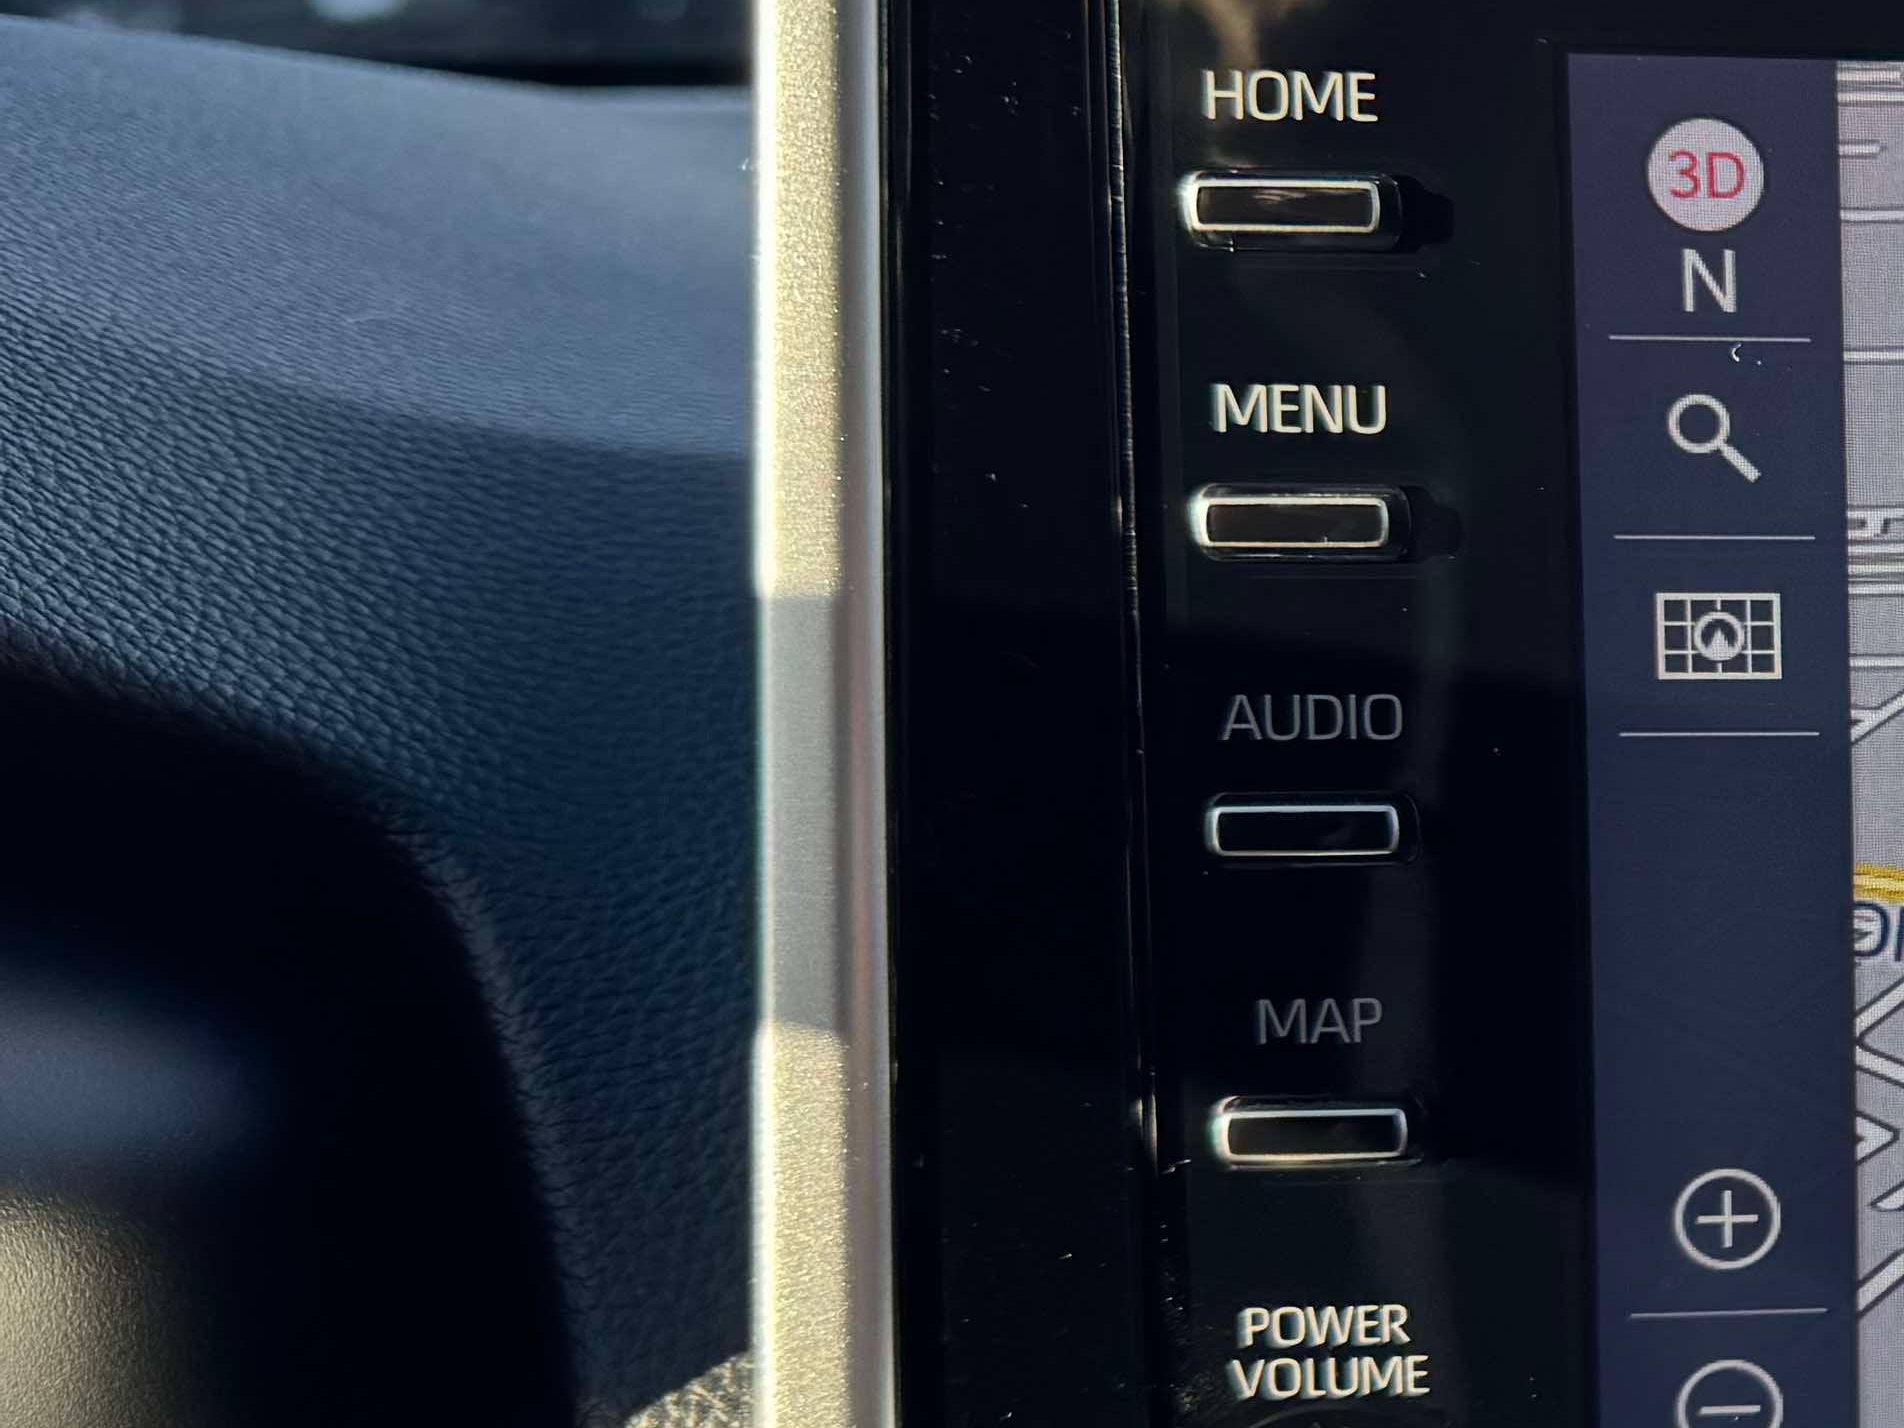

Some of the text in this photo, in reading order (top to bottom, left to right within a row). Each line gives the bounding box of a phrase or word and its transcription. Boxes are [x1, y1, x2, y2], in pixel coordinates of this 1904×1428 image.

[1201, 70, 1379, 122] HOME
[1667, 150, 1746, 200] 3D
[1682, 248, 1737, 312] N
[1210, 382, 1388, 435] MENU
[1219, 693, 1403, 741] AUDIO
[1254, 996, 1384, 1045] MAP
[1236, 1304, 1412, 1349] POWER
[1227, 1354, 1432, 1401] VOLUME
